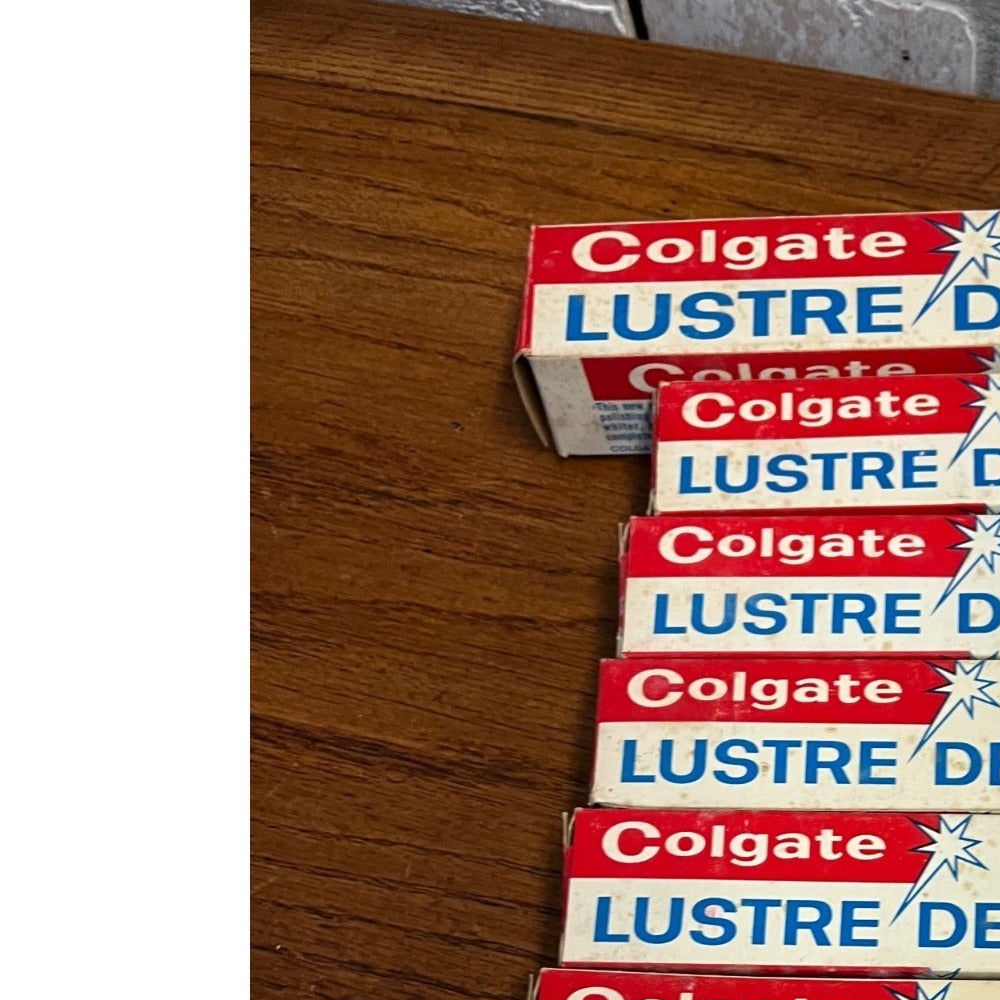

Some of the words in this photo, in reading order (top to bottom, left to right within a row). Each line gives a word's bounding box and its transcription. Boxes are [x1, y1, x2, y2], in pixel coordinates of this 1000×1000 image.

[572, 228, 907, 272] Colgate
[565, 285, 903, 341] LUSTRE
[682, 390, 940, 429] Colgate
[678, 450, 938, 494] LUSTRE
[658, 525, 926, 565] Colgate
[653, 592, 922, 635] LUSTRE
[627, 668, 903, 710] Colgate
[620, 738, 898, 785] LUSTRE
[601, 820, 887, 867] Colgate
[592, 895, 880, 947] LUSTRE
